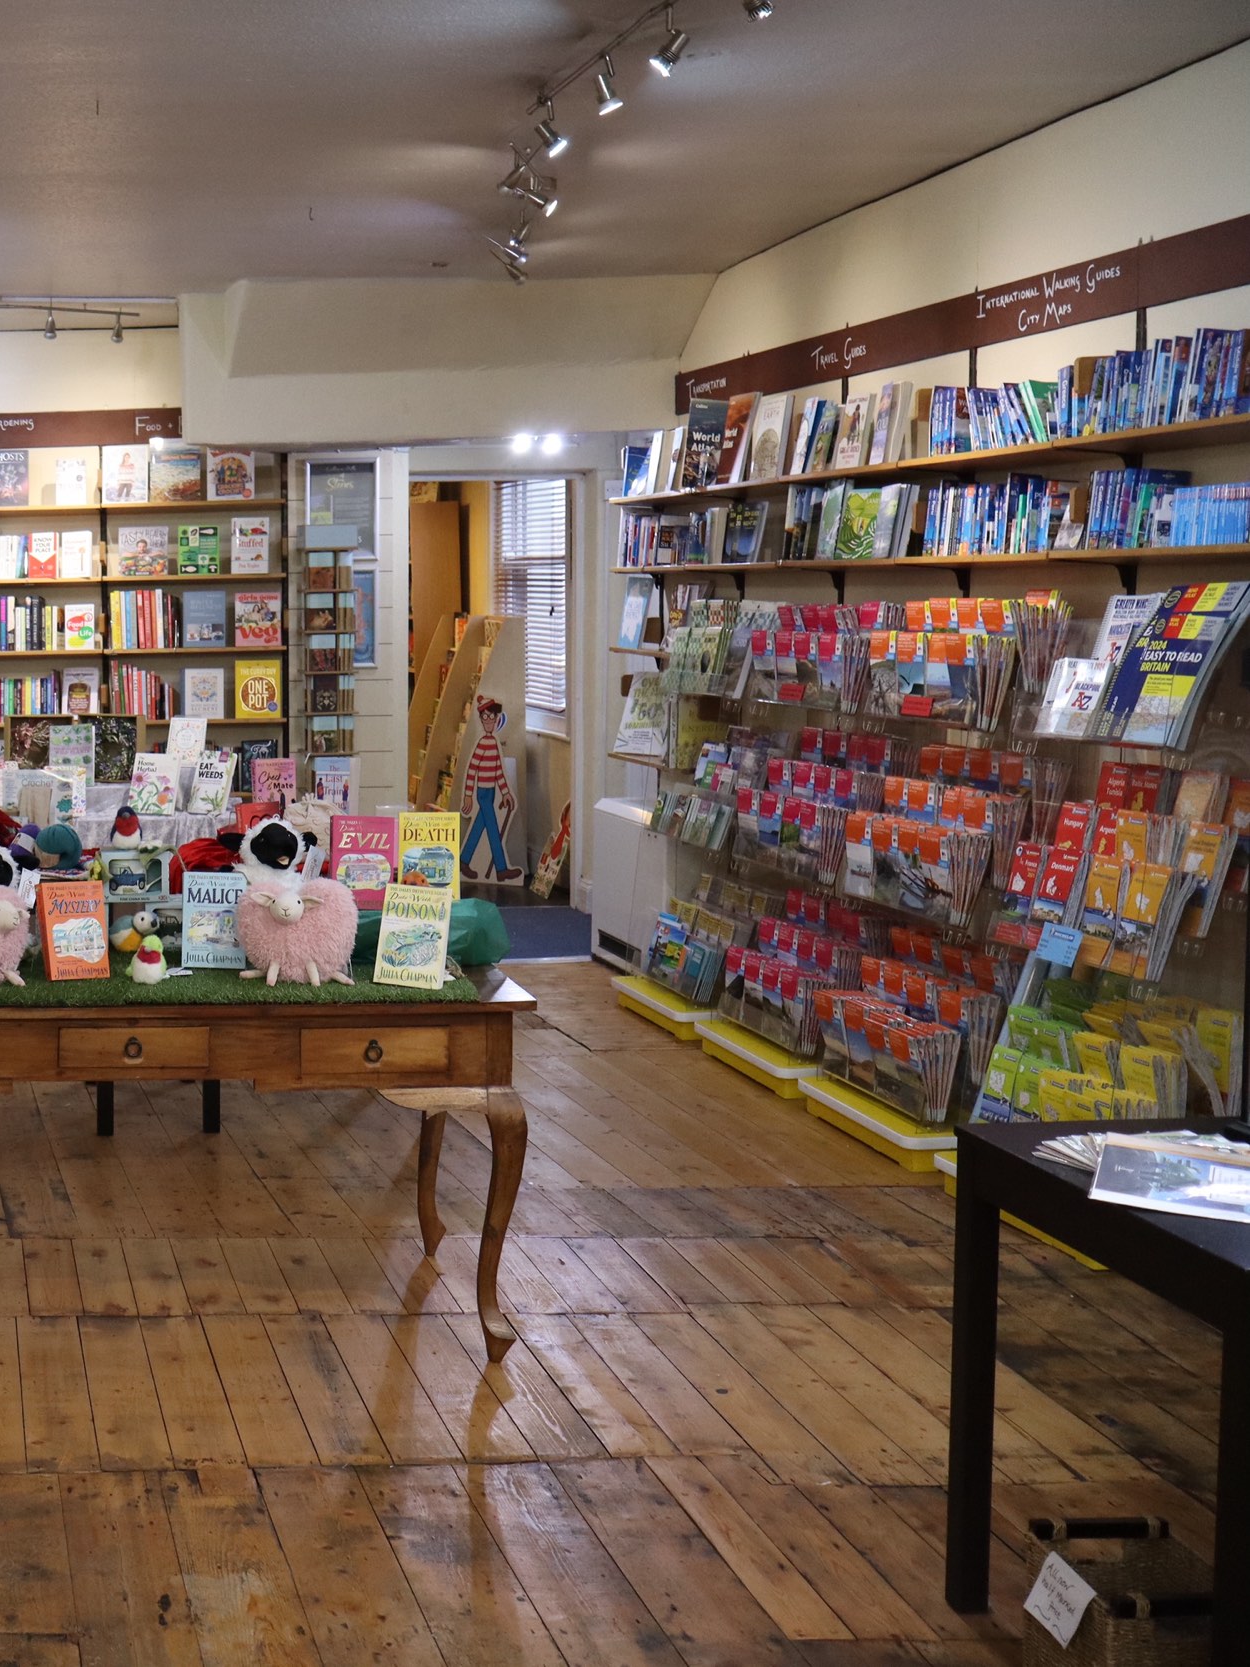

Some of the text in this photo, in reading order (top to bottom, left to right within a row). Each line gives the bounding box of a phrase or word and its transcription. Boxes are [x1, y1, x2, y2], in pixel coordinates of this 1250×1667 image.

[692, 431, 721, 443] World
[1149, 641, 1168, 650] 2024
[1144, 651, 1203, 663] EASY TO READ
[1140, 662, 1170, 672] BRITAIN
[247, 680, 269, 694] ONE
[1074, 682, 1100, 692] BLACKPOOL
[248, 694, 269, 708] POT
[200, 763, 213, 771] EAT
[198, 771, 224, 779] WEEDS
[258, 771, 281, 782] Check
[326, 774, 343, 783] Last
[1108, 778, 1126, 787] Algeria
[324, 787, 343, 796] Train
[1064, 818, 1083, 829] Hungary
[339, 832, 390, 849] EVIL
[403, 828, 456, 842] DEATH
[1025, 859, 1038, 868] France
[1050, 861, 1074, 873] Denmark
[187, 888, 243, 904] MALICE
[48, 900, 101, 915] MYSTERY
[386, 902, 439, 920] POISON
[184, 951, 243, 964] JULIA CHAPMAN
[55, 965, 108, 978] JULIA CHAPMAN
[378, 967, 438, 984] JULIA CHAPMAN
